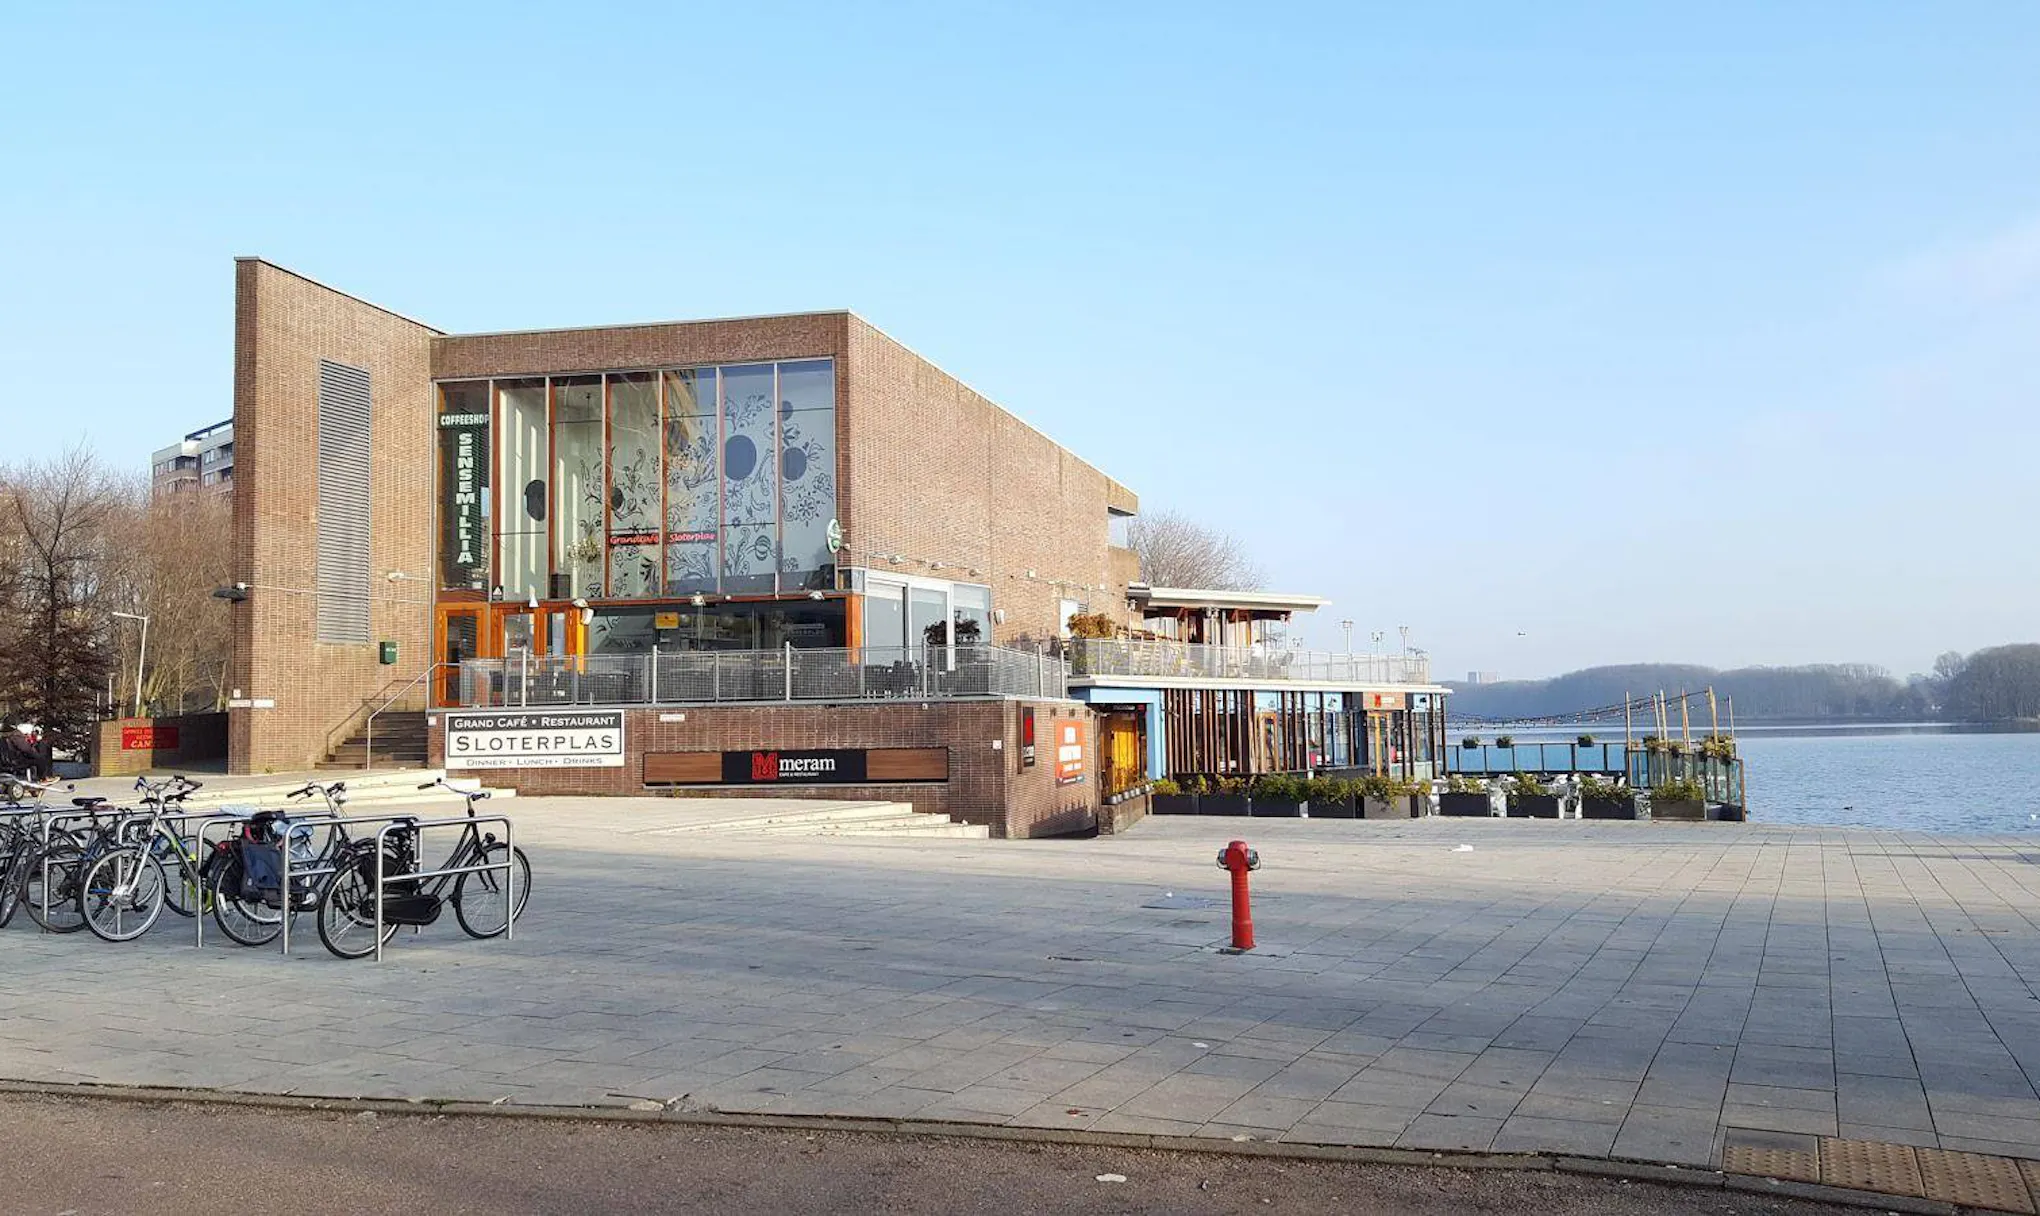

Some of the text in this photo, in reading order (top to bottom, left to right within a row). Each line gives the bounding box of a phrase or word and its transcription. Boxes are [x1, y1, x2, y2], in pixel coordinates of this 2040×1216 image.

[440, 414, 489, 426] COFFEESHOP
[455, 432, 476, 564] SENSEMILLIA
[454, 718, 494, 729] GRAND
[541, 716, 615, 727] RESTAURANT
[456, 735, 613, 752] SLOTERPLAS
[466, 757, 603, 767] DINNER LUNCH DRINKS
[779, 758, 836, 771] meram
